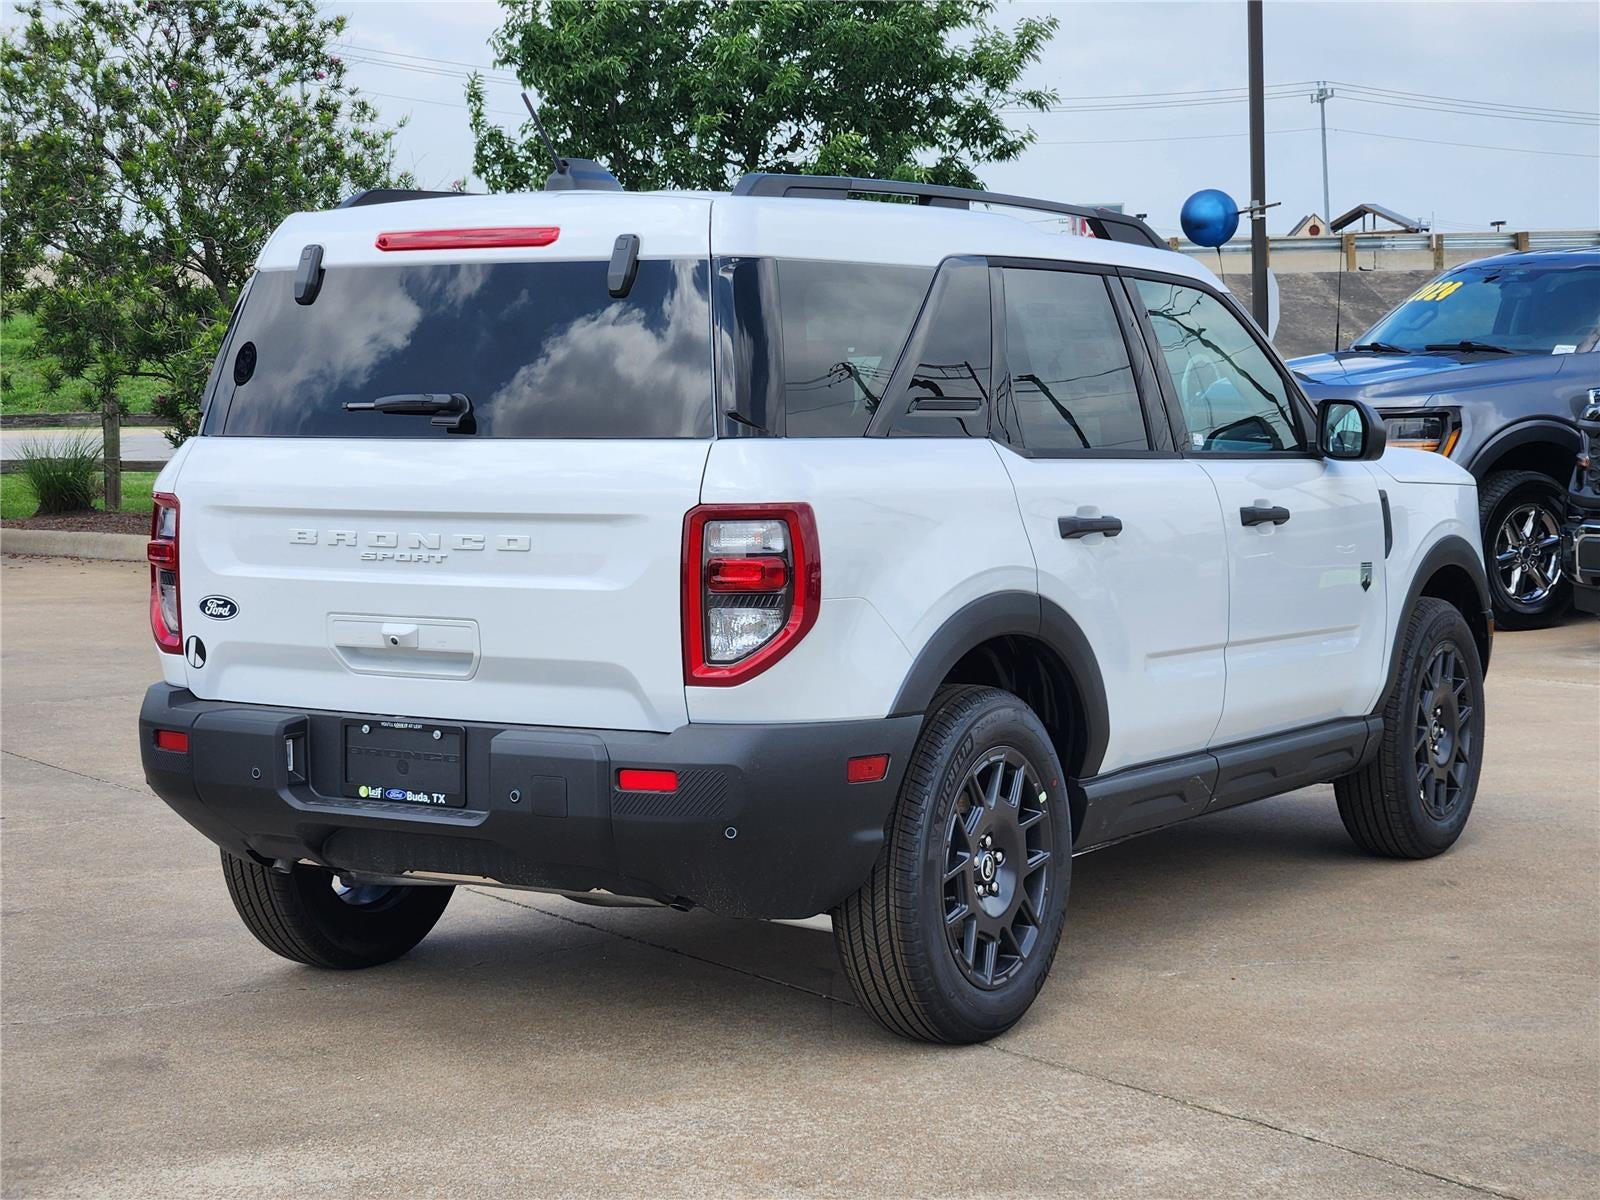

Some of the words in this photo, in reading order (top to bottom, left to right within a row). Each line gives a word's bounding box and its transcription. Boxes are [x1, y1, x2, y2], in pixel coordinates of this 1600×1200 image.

[288, 528, 531, 551] BRONCO
[360, 551, 448, 564] SPORT
[205, 599, 231, 616] Ford
[406, 791, 430, 803] Buda,
[432, 793, 446, 804] TX
